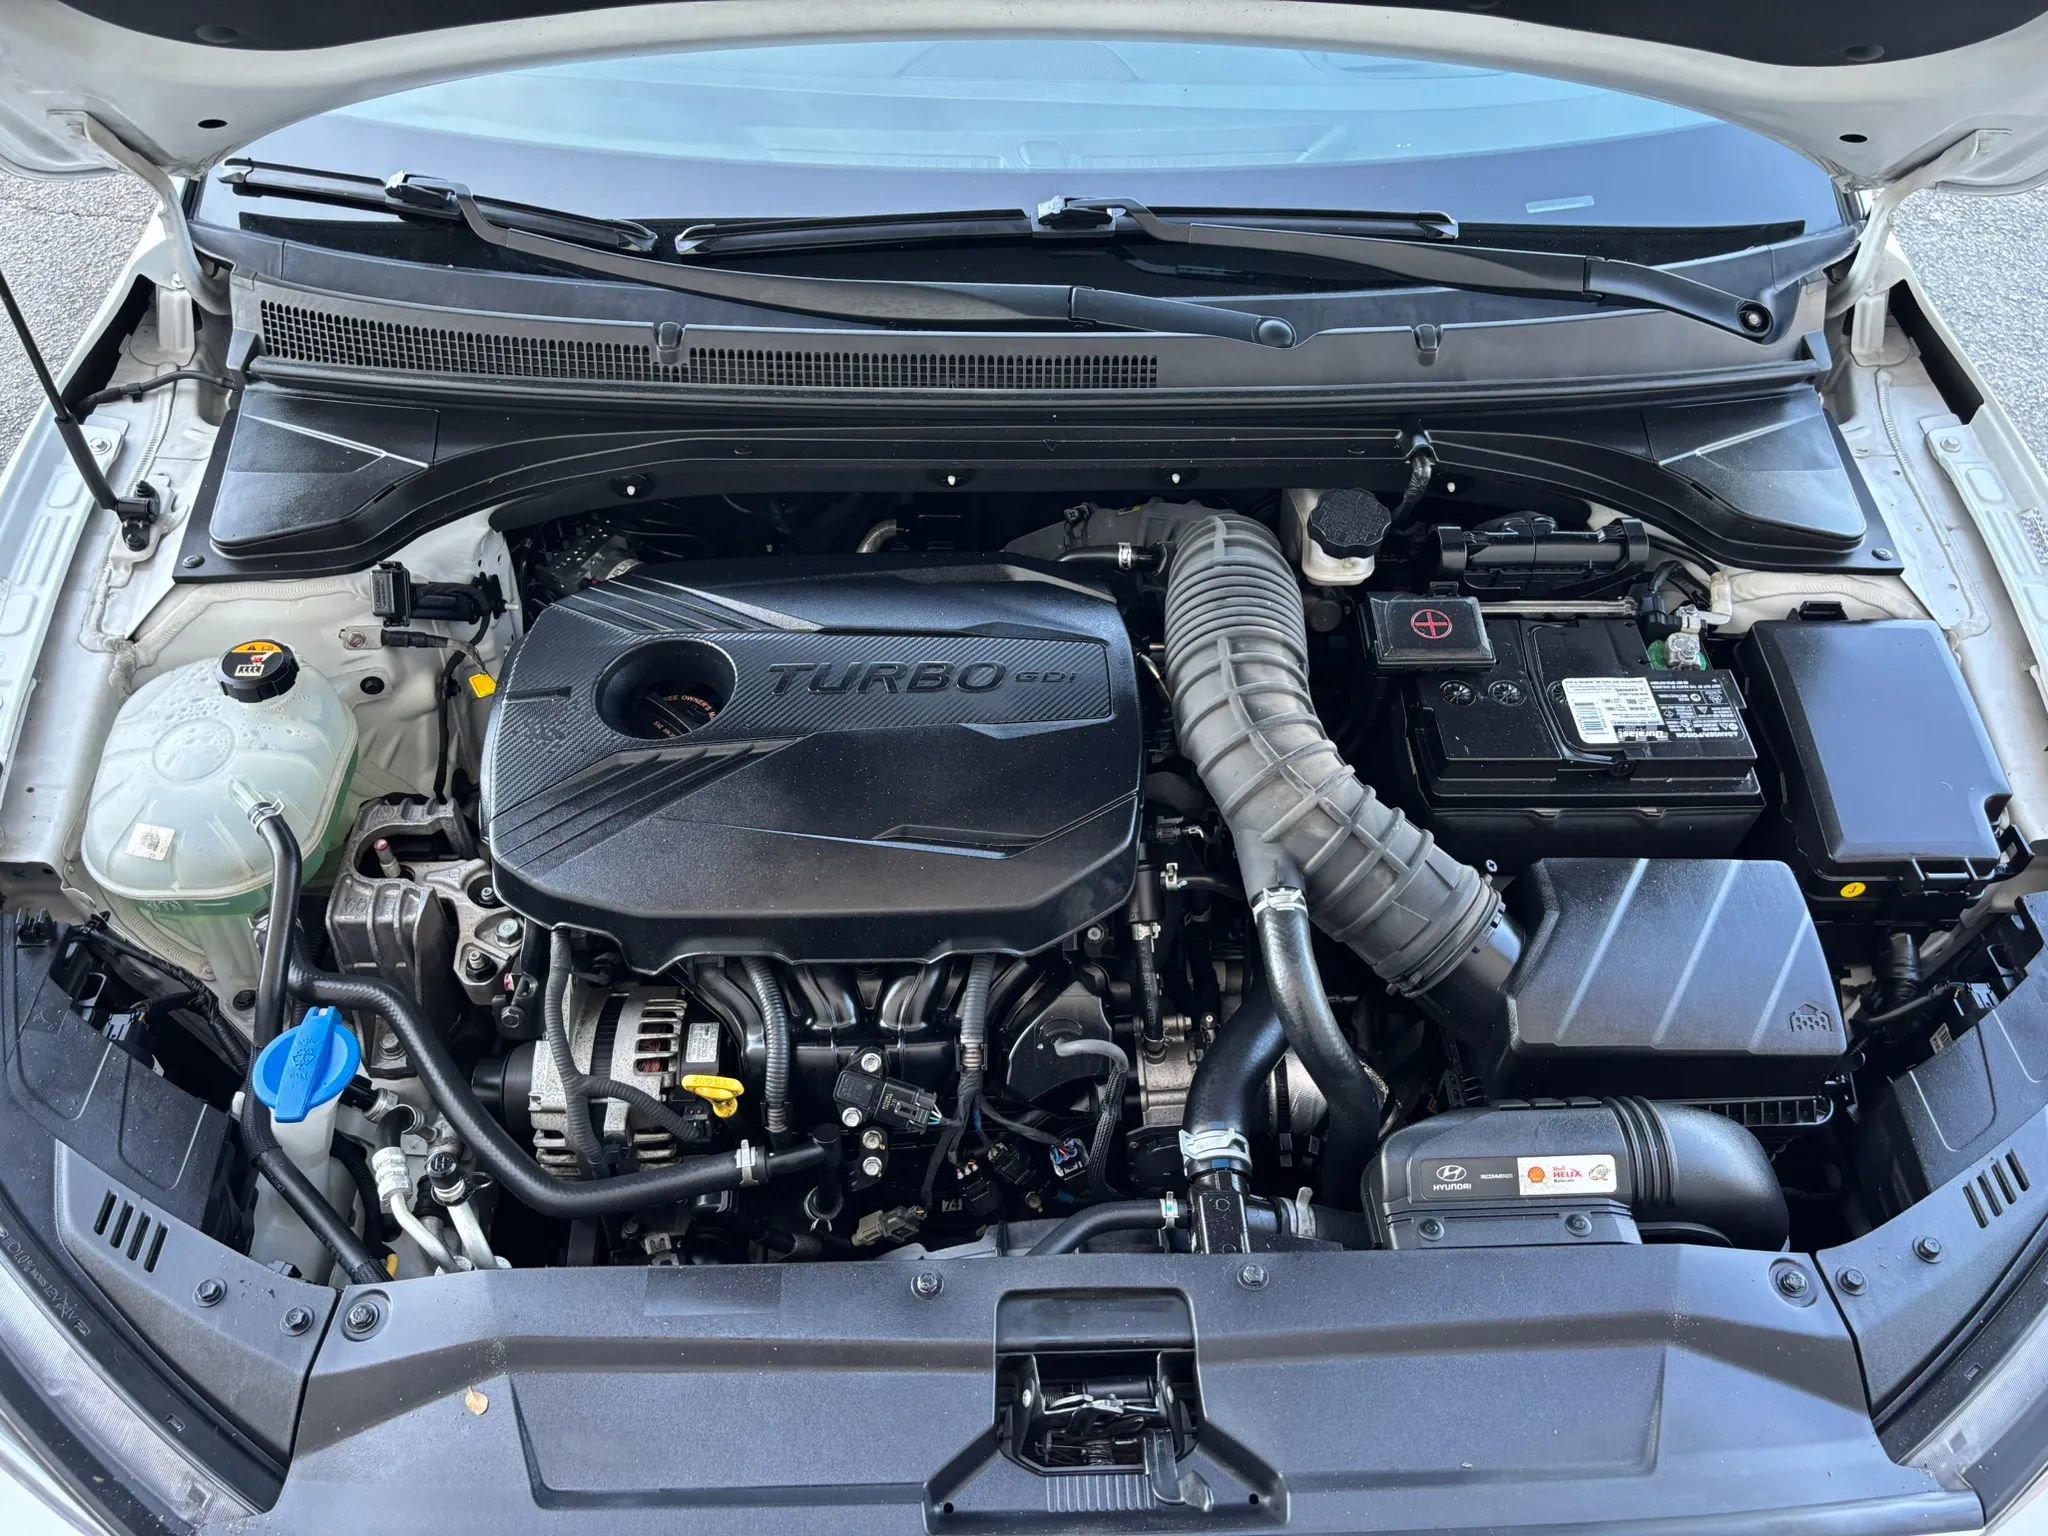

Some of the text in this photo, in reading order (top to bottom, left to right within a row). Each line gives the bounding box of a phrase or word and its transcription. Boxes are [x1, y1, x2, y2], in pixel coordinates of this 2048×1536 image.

[767, 660, 1006, 695] TURBO
[1617, 729, 1665, 739] Duralast
[1553, 1169, 1583, 1178] HELIX
[1432, 1183, 1472, 1191] HYUNDAI
